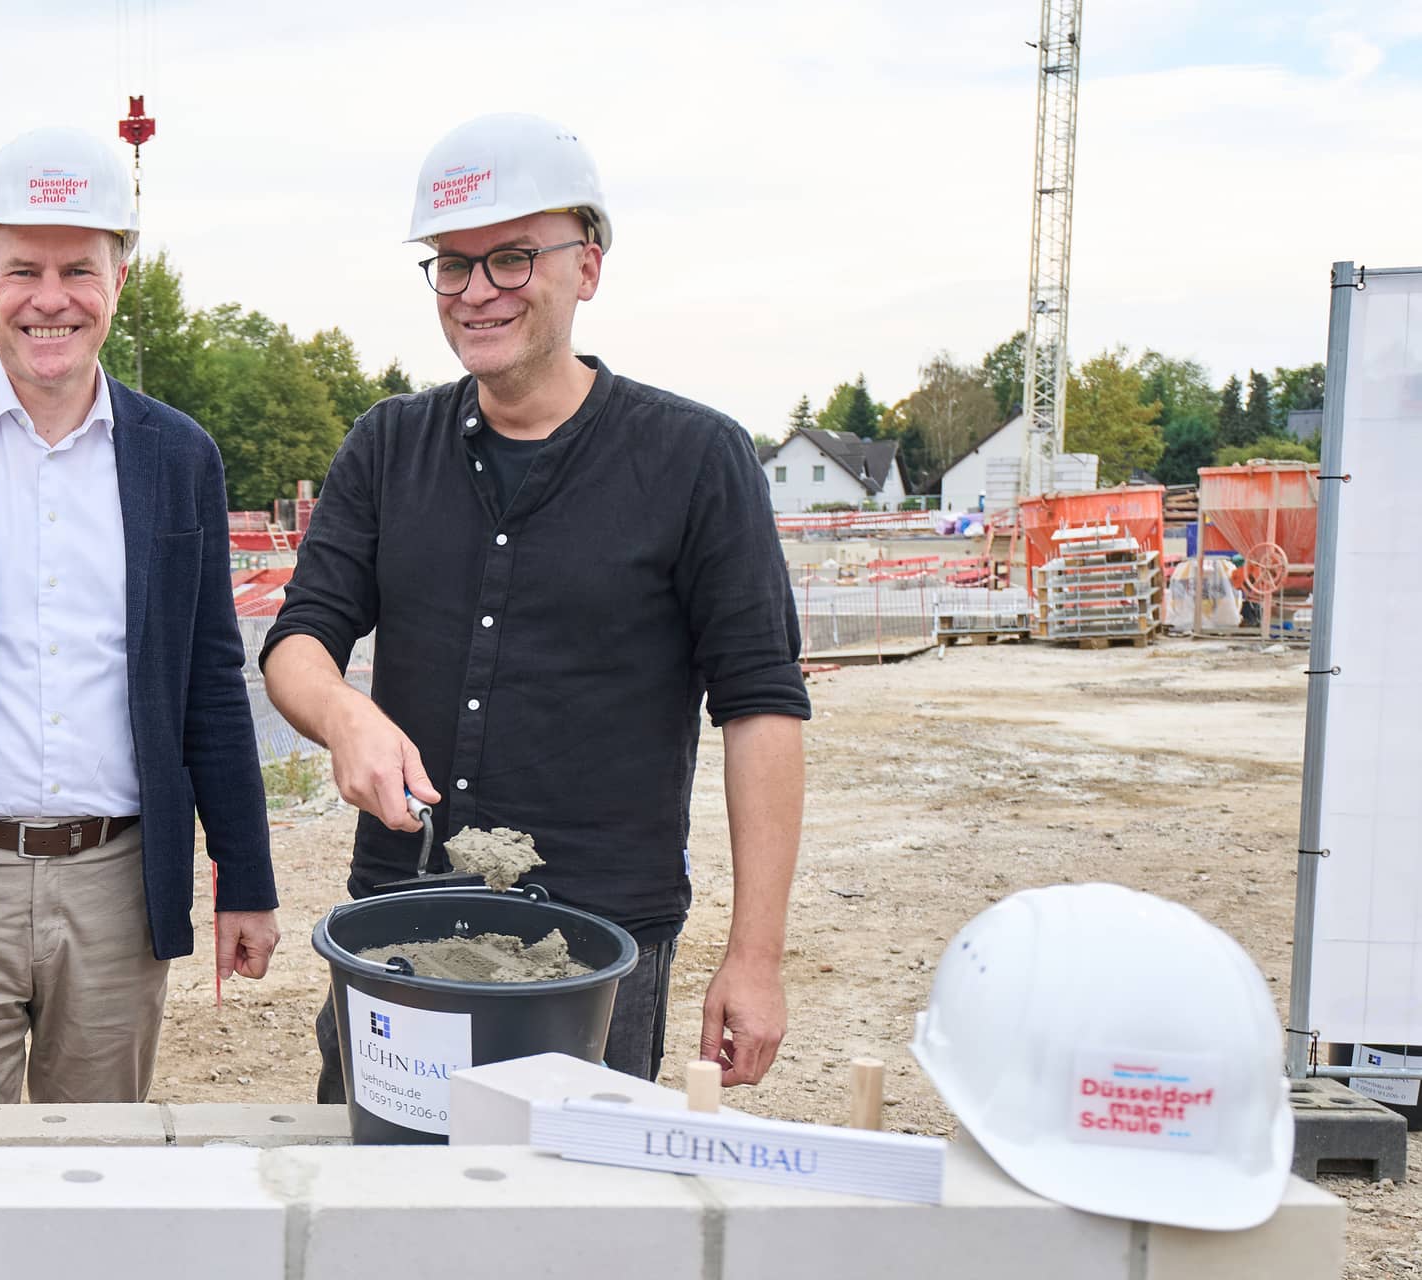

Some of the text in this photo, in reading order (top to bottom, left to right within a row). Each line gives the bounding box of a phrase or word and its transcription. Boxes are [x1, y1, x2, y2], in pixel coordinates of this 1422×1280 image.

[30, 178, 88, 189] Düsseldorf
[42, 187, 76, 195] macht
[433, 170, 491, 192] Düsseldorf
[444, 183, 479, 197] macht
[30, 195, 67, 204] Schule
[433, 195, 468, 209] Schule
[1036, 300, 1046, 314] 2
[359, 1039, 458, 1080] LÜHN BAU
[361, 1067, 422, 1100] luehnbau.de
[1081, 1079, 1213, 1105] Düsseldorf
[362, 1086, 448, 1121] T 0591 91206-0
[1110, 1102, 1185, 1120] macht
[1081, 1111, 1162, 1134] Schule
[645, 1129, 818, 1174] LÜHN BAU
